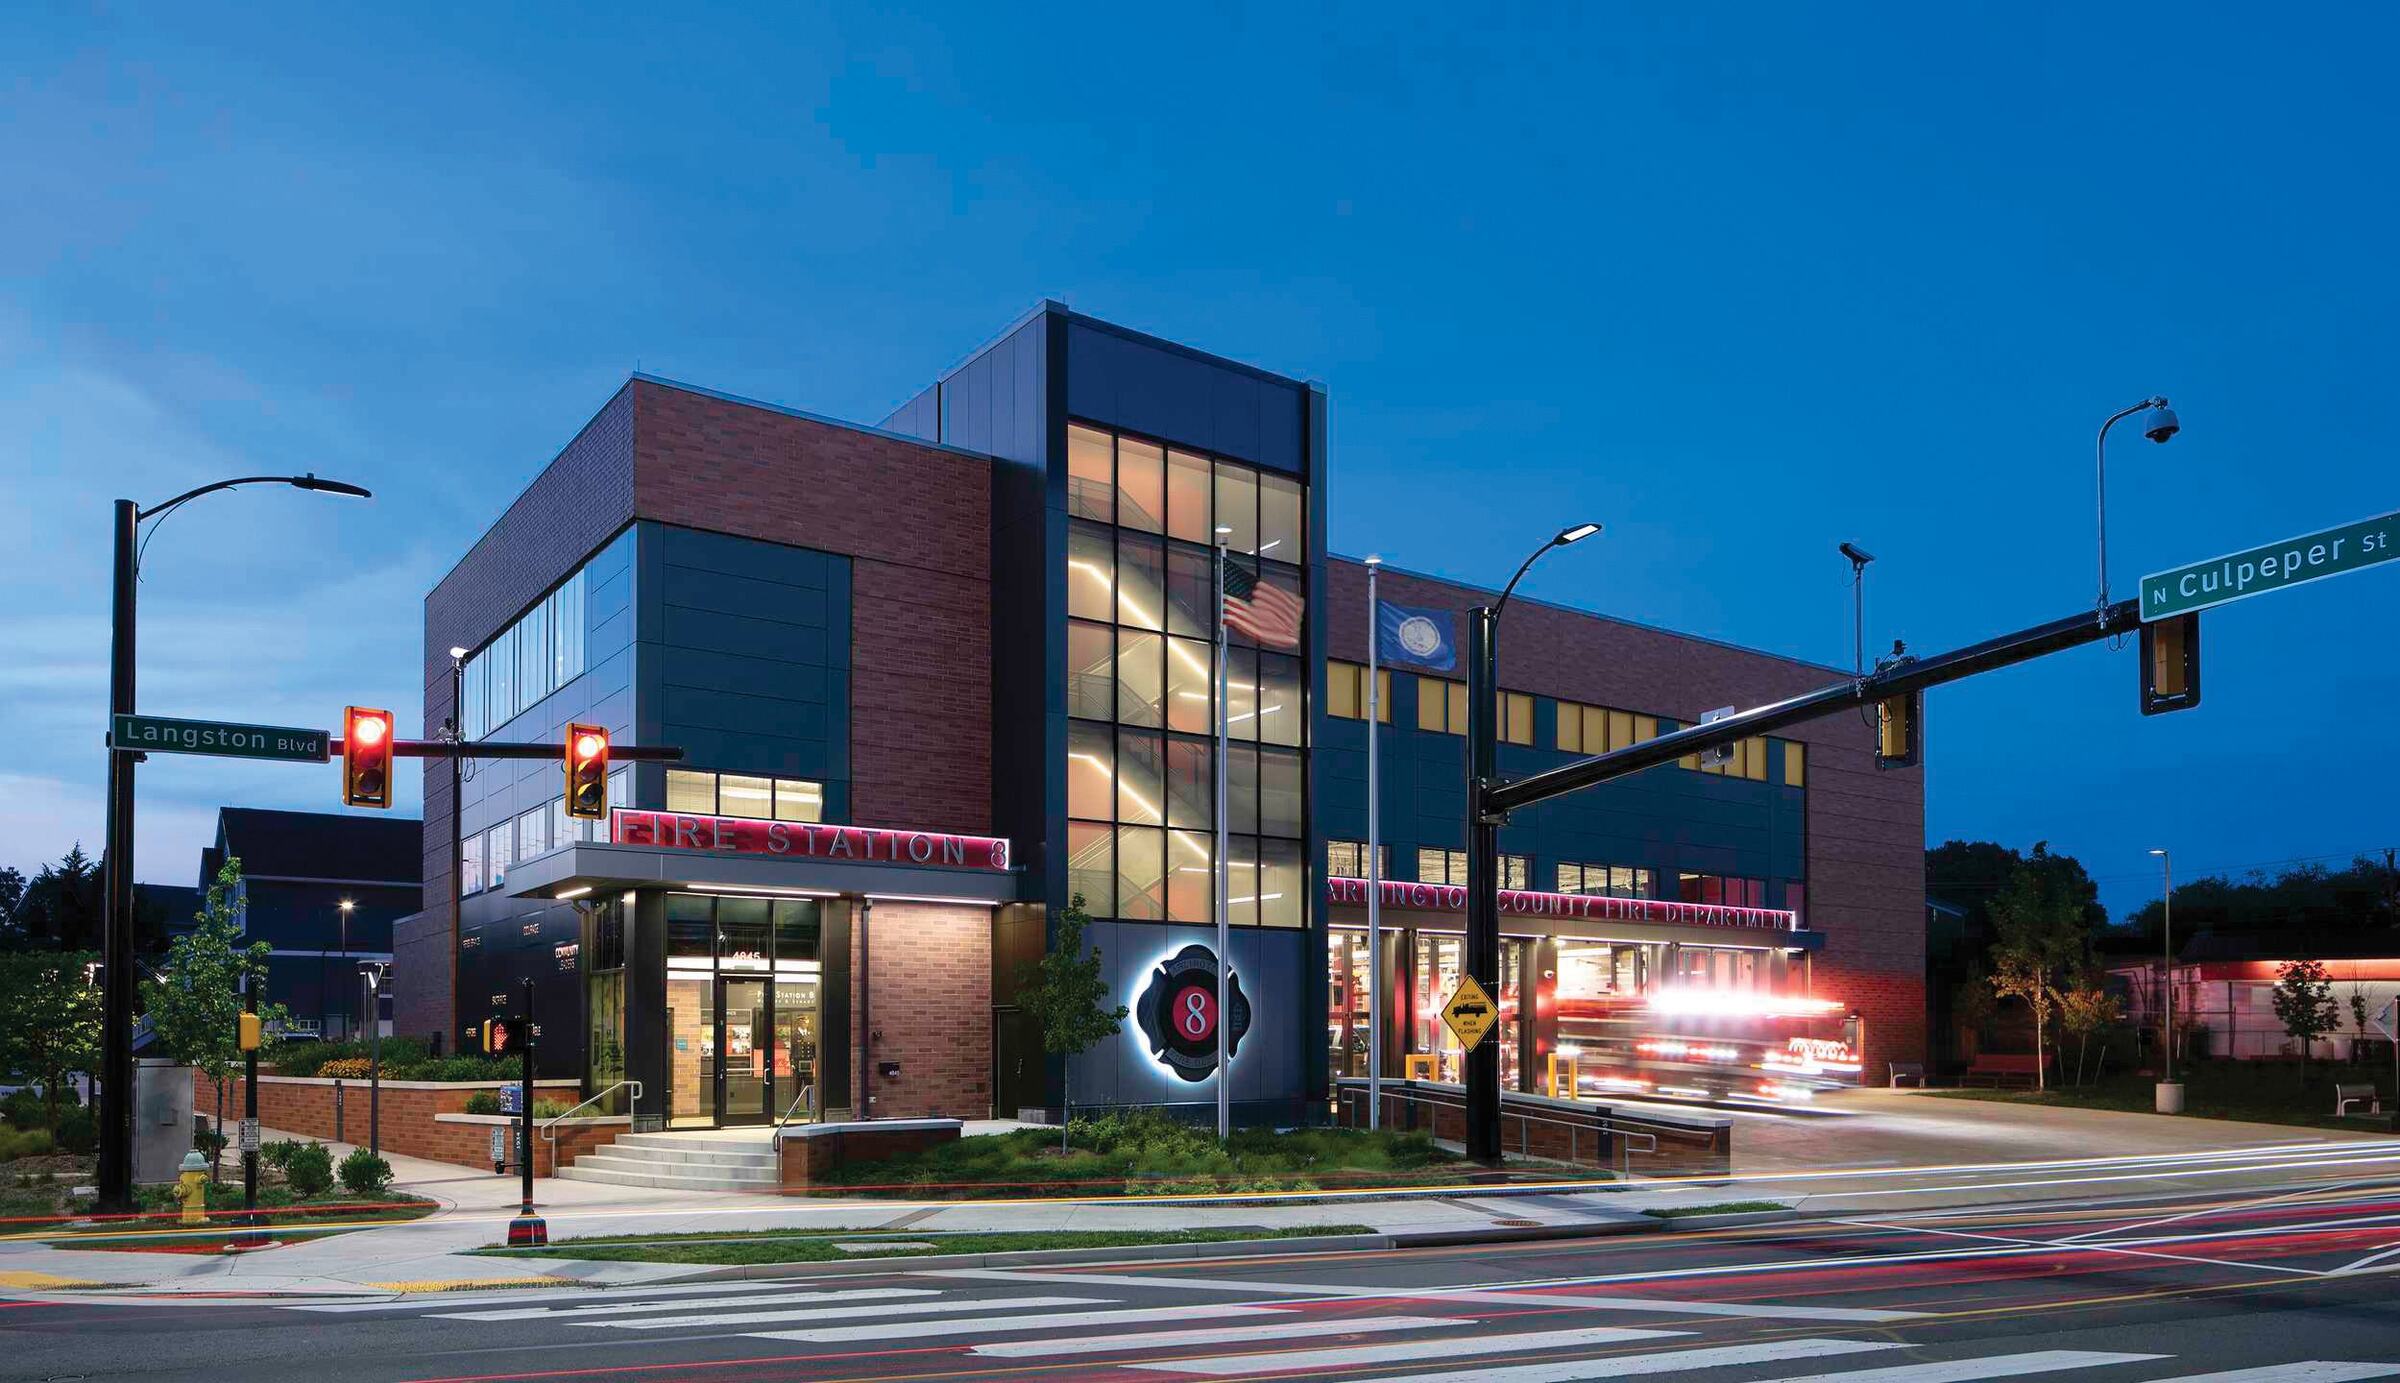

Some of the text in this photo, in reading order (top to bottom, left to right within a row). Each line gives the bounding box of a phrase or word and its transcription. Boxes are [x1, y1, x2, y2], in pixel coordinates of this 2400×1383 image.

[2153, 531, 2387, 605] N Culpeper St
[127, 721, 317, 753] Langston Blvd
[618, 811, 1006, 868] FIRE STATION 8
[1327, 878, 1795, 931] ARLINGTO COUNTY FIRE DEPARTMENT
[1185, 993, 1206, 1035] 8
